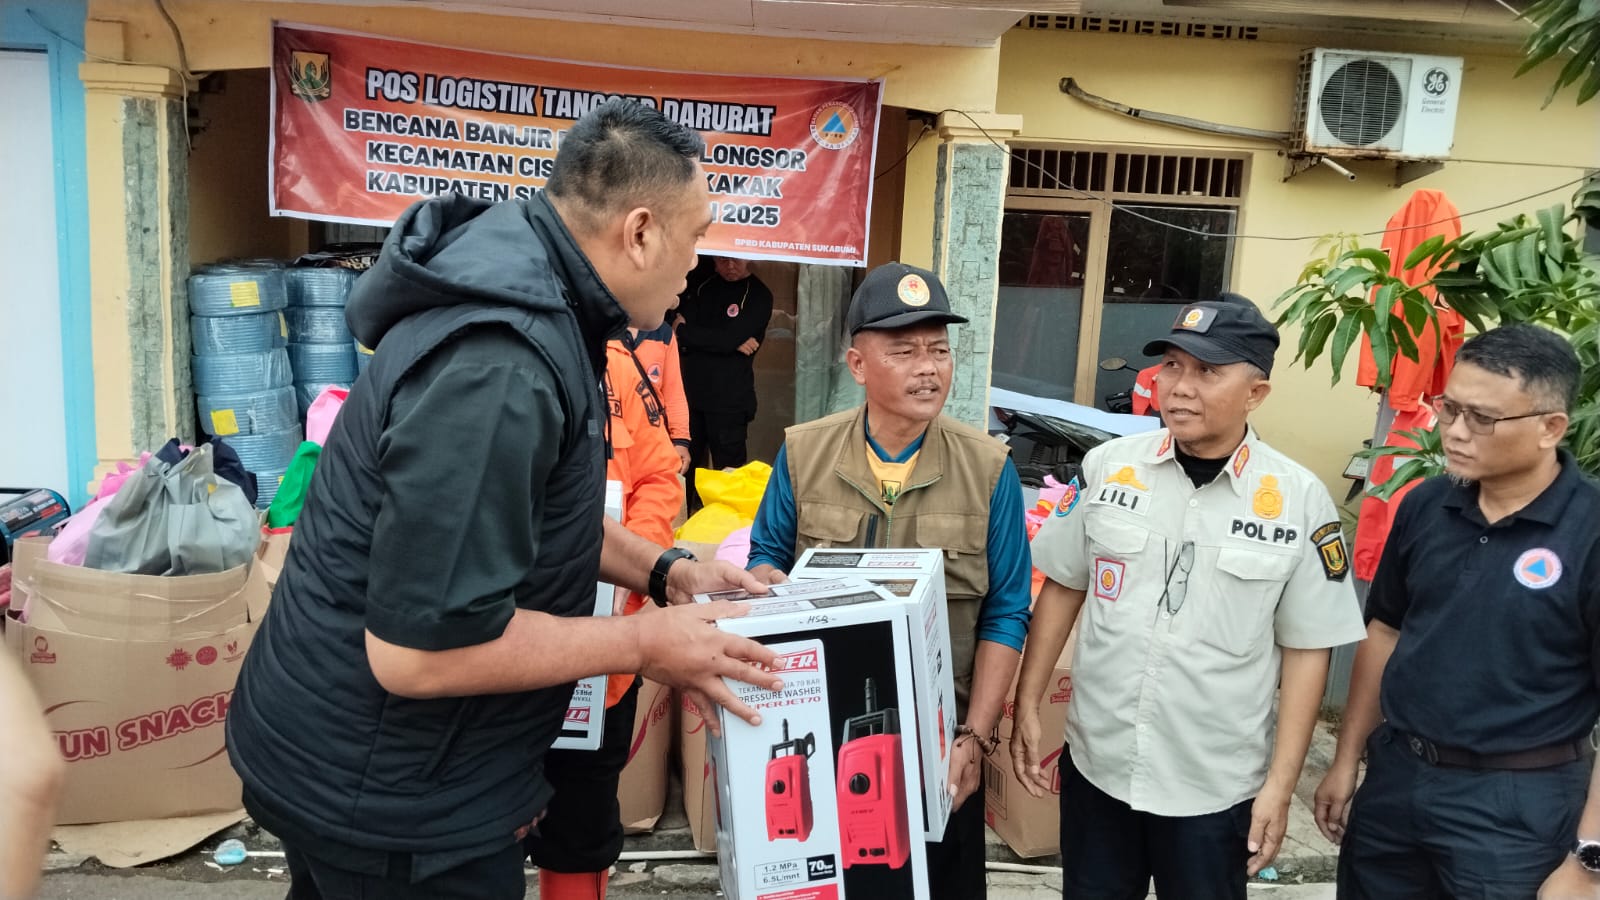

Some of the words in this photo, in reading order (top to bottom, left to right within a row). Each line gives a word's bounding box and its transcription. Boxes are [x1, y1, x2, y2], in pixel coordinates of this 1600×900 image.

[367, 68, 419, 102] POS
[424, 75, 538, 115] LOGISTIK
[662, 98, 776, 136] DARURAT
[345, 109, 460, 140] BENCANA
[465, 121, 552, 149] BANJIR
[700, 144, 807, 171] LONGSOR
[367, 142, 515, 175] KECAMATAN
[707, 173, 783, 198] KAKAK
[722, 203, 780, 226] 2025
[758, 240, 811, 251] KABUPATEN
[1099, 488, 1139, 510] LILI
[1231, 519, 1267, 541] POL
[1272, 526, 1297, 545] PP
[738, 690, 783, 704] PRESSURE
[784, 687, 821, 699] WASHER
